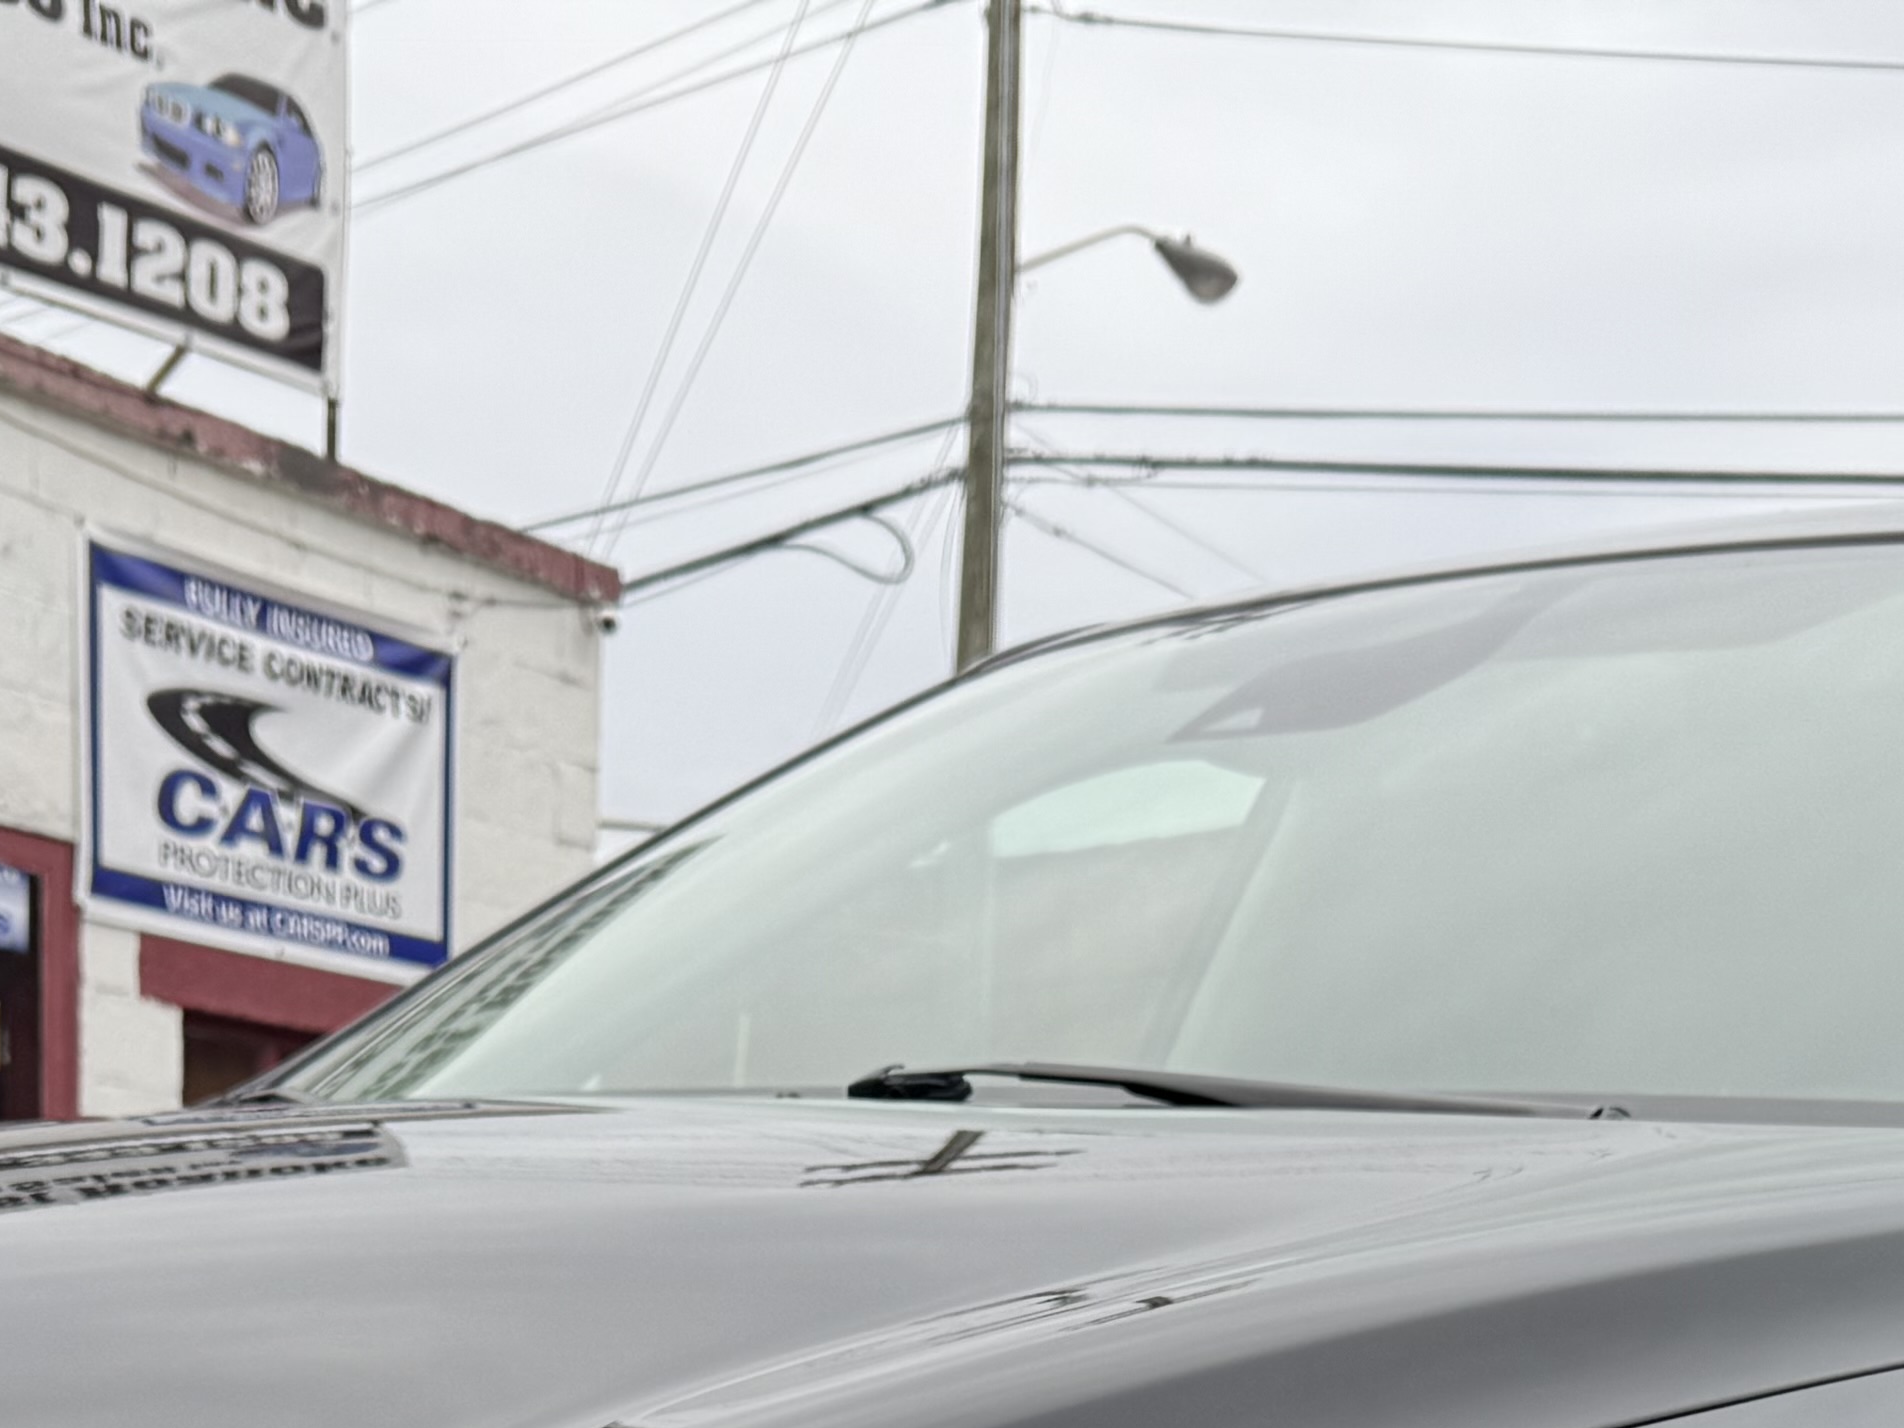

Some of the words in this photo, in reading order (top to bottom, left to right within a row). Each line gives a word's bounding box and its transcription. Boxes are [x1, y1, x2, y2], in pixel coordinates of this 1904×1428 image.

[119, 605, 255, 674] SERVICE
[157, 768, 406, 883] CARS
[158, 841, 336, 902] PROTECTION
[340, 877, 403, 920] PLUS
